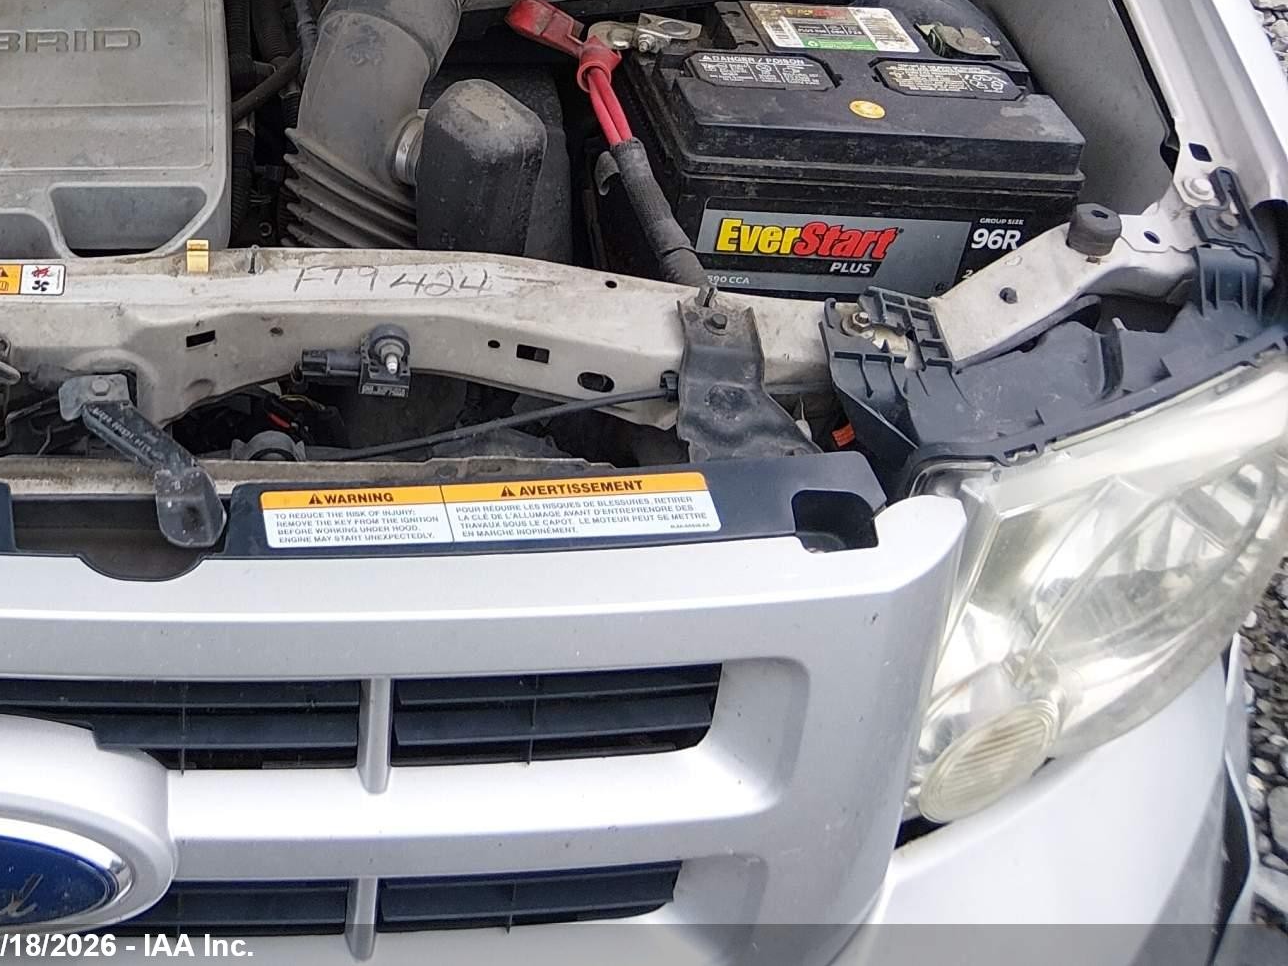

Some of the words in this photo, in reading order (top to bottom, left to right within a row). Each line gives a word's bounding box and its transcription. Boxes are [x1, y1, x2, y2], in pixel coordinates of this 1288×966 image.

[712, 55, 756, 64] DANGER
[765, 57, 805, 65] POISON
[714, 218, 896, 261] EverStart
[971, 228, 1021, 250] 96R
[829, 261, 872, 275] PLUS
[728, 276, 750, 285] CCA
[520, 480, 643, 496] AVERTISSEMENT
[324, 492, 394, 505] WARNING
[456, 506, 480, 514] POUR
[523, 503, 540, 511] LES
[542, 501, 581, 510] RISQUES
[583, 500, 594, 508] DE
[654, 495, 692, 504] RETIRER
[274, 513, 286, 521] TO
[288, 512, 323, 520] REDUCE
[326, 511, 343, 519] THE
[346, 510, 366, 518] RISK
[461, 522, 500, 530] TRAVAUX
[502, 520, 527, 528] SOUS
[578, 517, 590, 525] LE
[592, 515, 630, 524] MOTEUR
[632, 514, 654, 522] PEUT
[657, 513, 669, 521] SE
[672, 511, 707, 520] METTRE
[492, 513, 504, 521] DE
[563, 509, 590, 517] AVANT
[276, 520, 312, 529] REMOVE
[316, 519, 332, 527] THE
[334, 518, 352, 526] KEY
[354, 517, 380, 526] FROM
[382, 516, 398, 524] THE
[400, 515, 439, 524] IGNITION
[277, 528, 313, 537] BEFORE
[316, 526, 358, 535] WORKING
[360, 525, 390, 533] UNDER
[462, 531, 474, 539] EN
[279, 536, 312, 545] ENGINE
[314, 536, 332, 544] MAY
[334, 534, 362, 543] START
